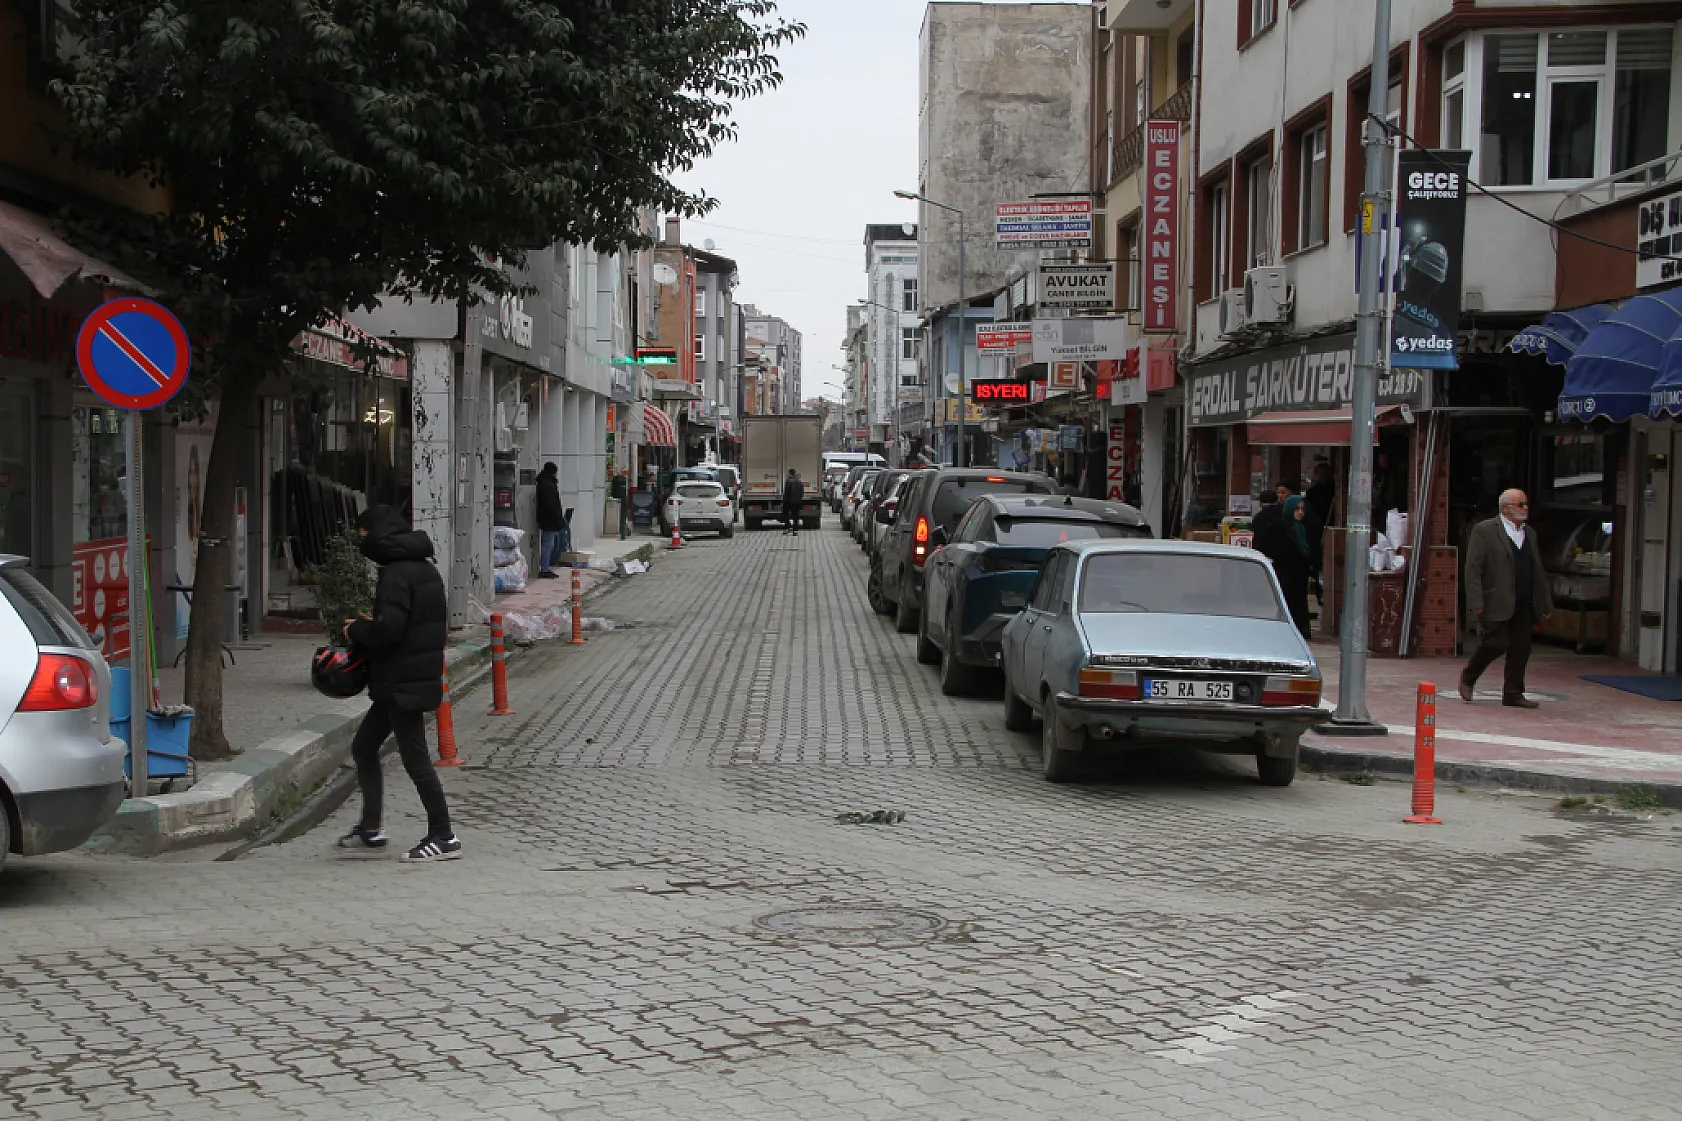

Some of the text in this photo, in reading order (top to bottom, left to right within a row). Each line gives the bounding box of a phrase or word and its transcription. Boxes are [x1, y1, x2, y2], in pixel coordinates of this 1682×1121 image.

[1150, 128, 1176, 143] USLU
[1408, 172, 1459, 190] GECE
[1152, 150, 1172, 326] ECZANESİ
[1046, 276, 1107, 287] AVUKAT
[1408, 334, 1454, 352] yedaş
[1057, 363, 1073, 384] E
[1192, 370, 1240, 416] ERDAL
[1152, 681, 1231, 699] 55 RA 525
